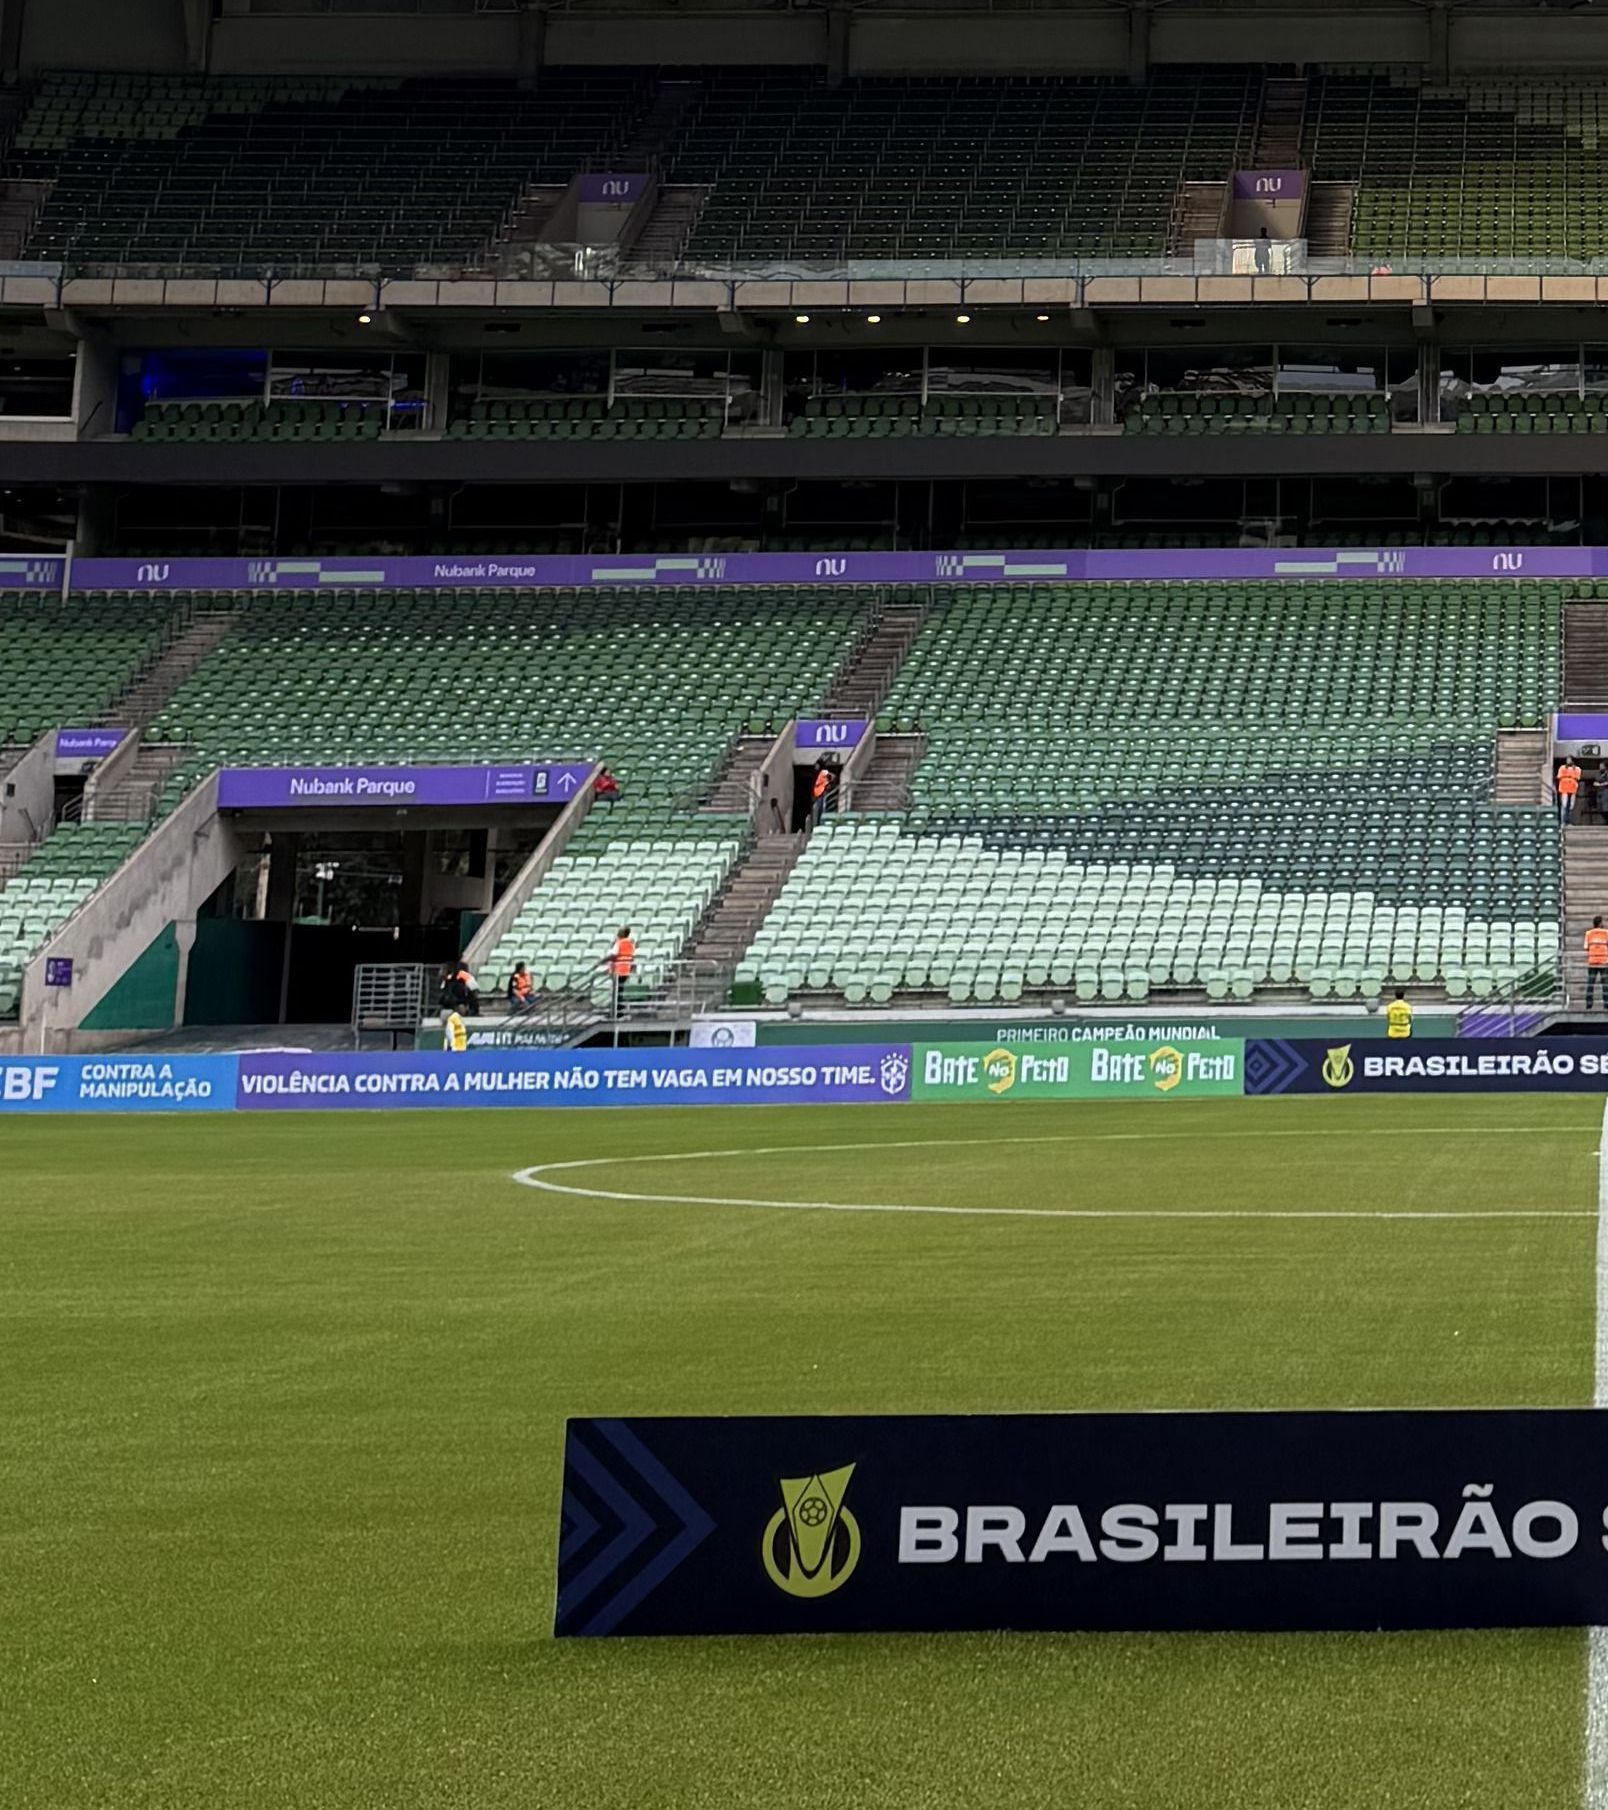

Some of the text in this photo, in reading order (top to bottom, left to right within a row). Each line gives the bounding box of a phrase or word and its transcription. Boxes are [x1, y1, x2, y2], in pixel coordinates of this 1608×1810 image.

[434, 564, 535, 578] Nubank Parque
[290, 778, 415, 797] Nubank Parque
[1072, 1024, 1145, 1041] CAMPEÃO
[82, 1064, 173, 1080] CONTRA A
[1364, 1050, 1574, 1076] BRASILEIRÃO
[0, 1067, 59, 1099] BF
[242, 1066, 875, 1093] VIOLÊNCIA CONTRA A MULHER NÃO TEM VAGA EM NOSSO TIME.
[80, 1080, 211, 1101] MANIPULAÇÃO
[899, 1484, 1578, 1562] BRASILEIRÃO
